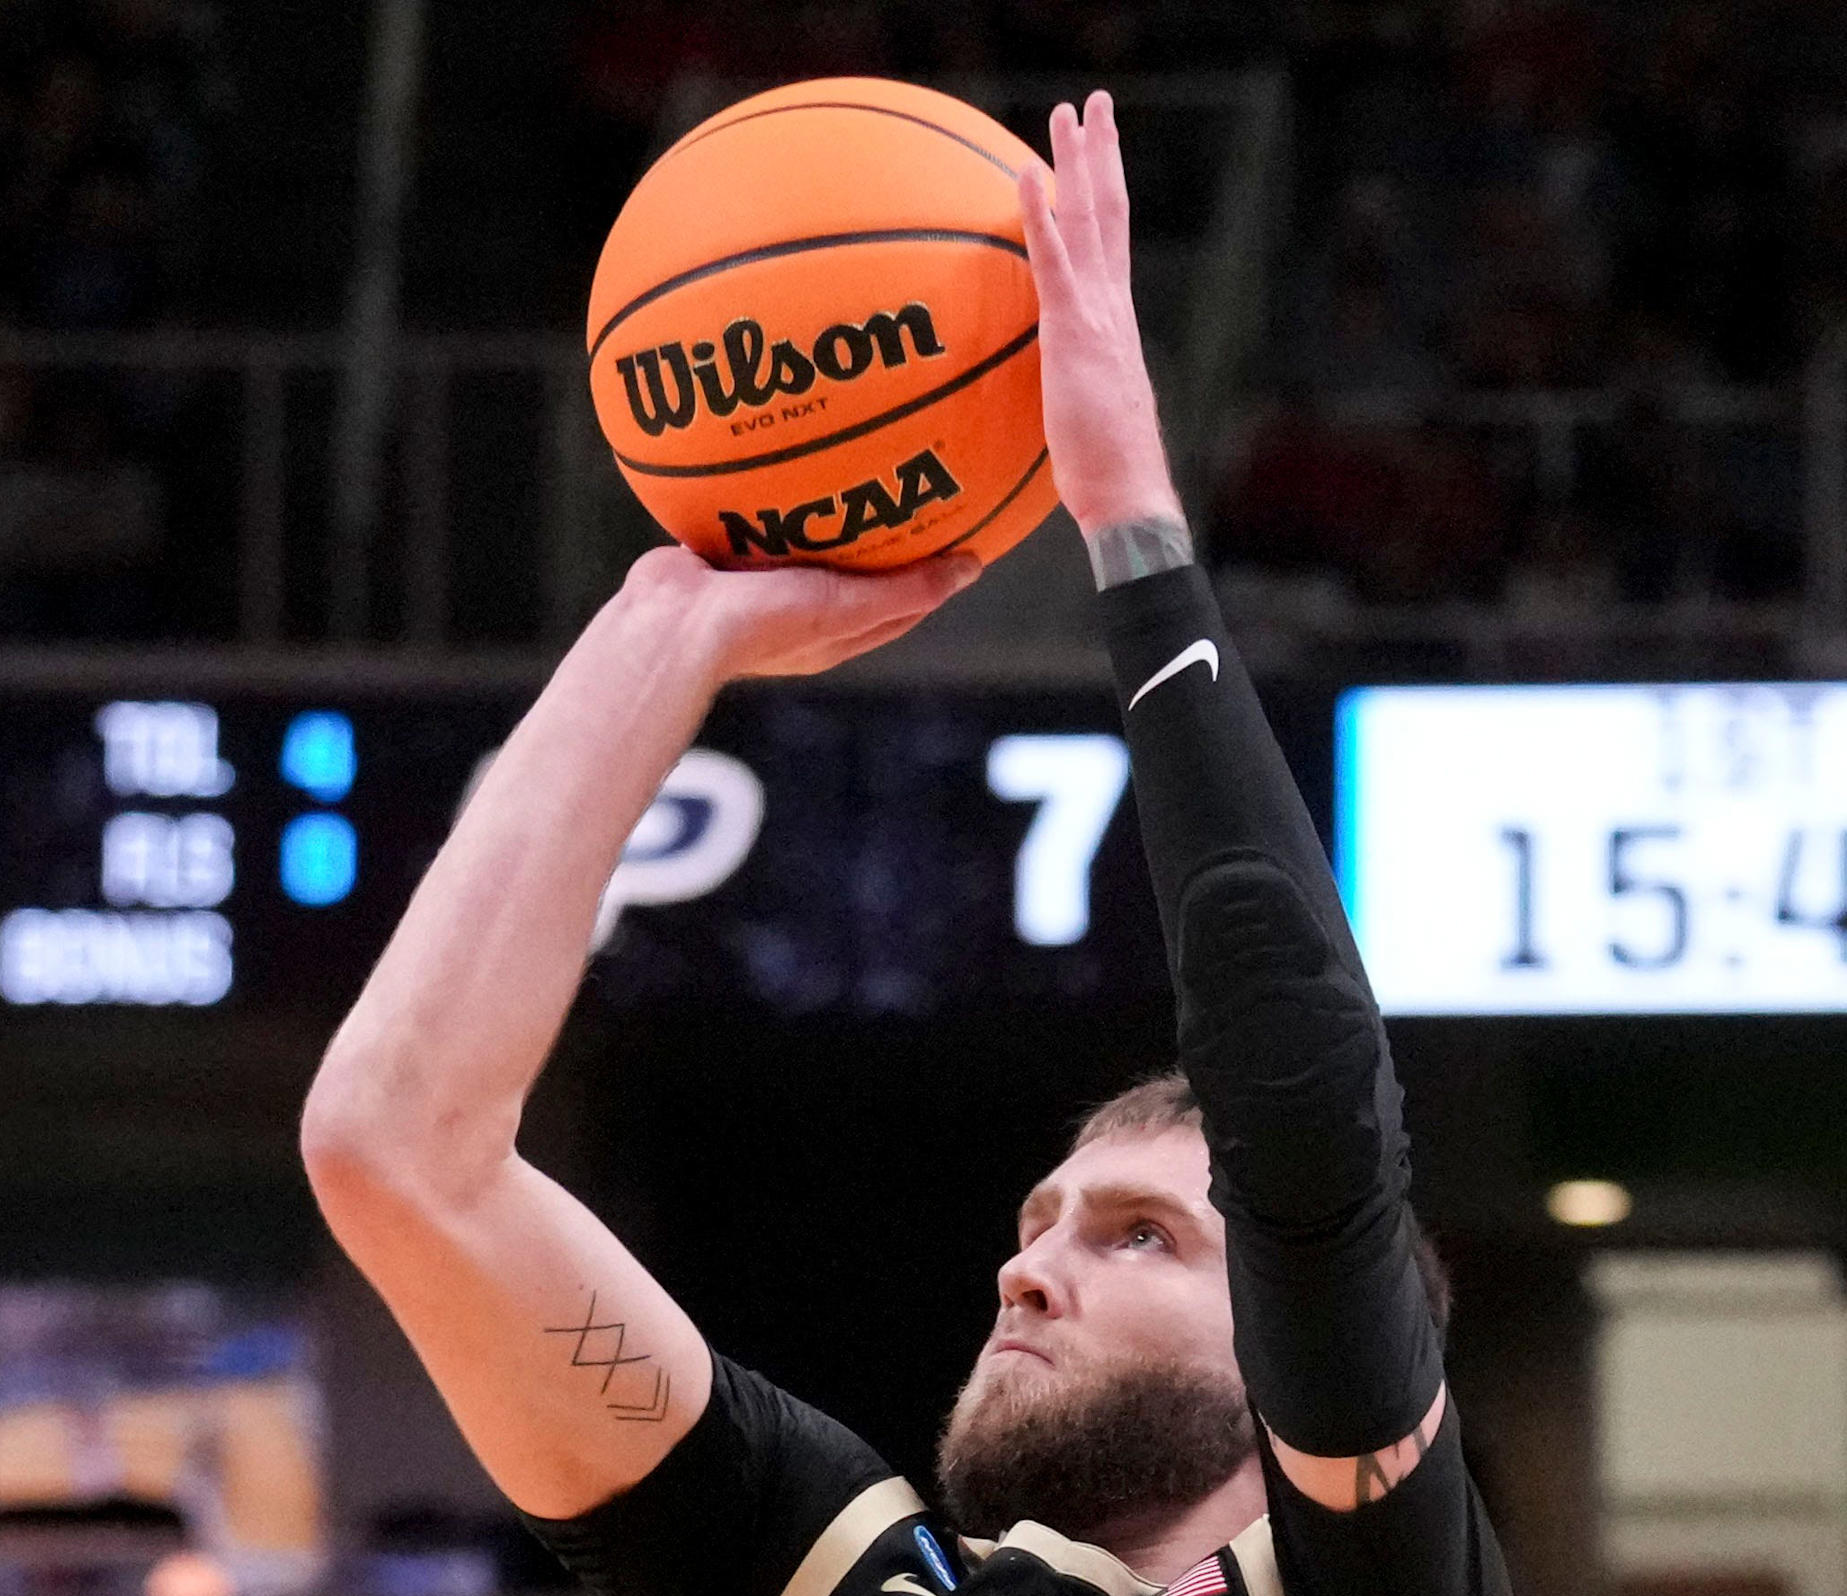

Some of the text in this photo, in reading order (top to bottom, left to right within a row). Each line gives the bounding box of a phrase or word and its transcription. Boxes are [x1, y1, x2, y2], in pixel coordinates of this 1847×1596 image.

[616, 300, 947, 437] Wilson
[729, 397, 830, 437] EVO NXT
[717, 447, 965, 557] NCAA
[986, 734, 1130, 945] 7
